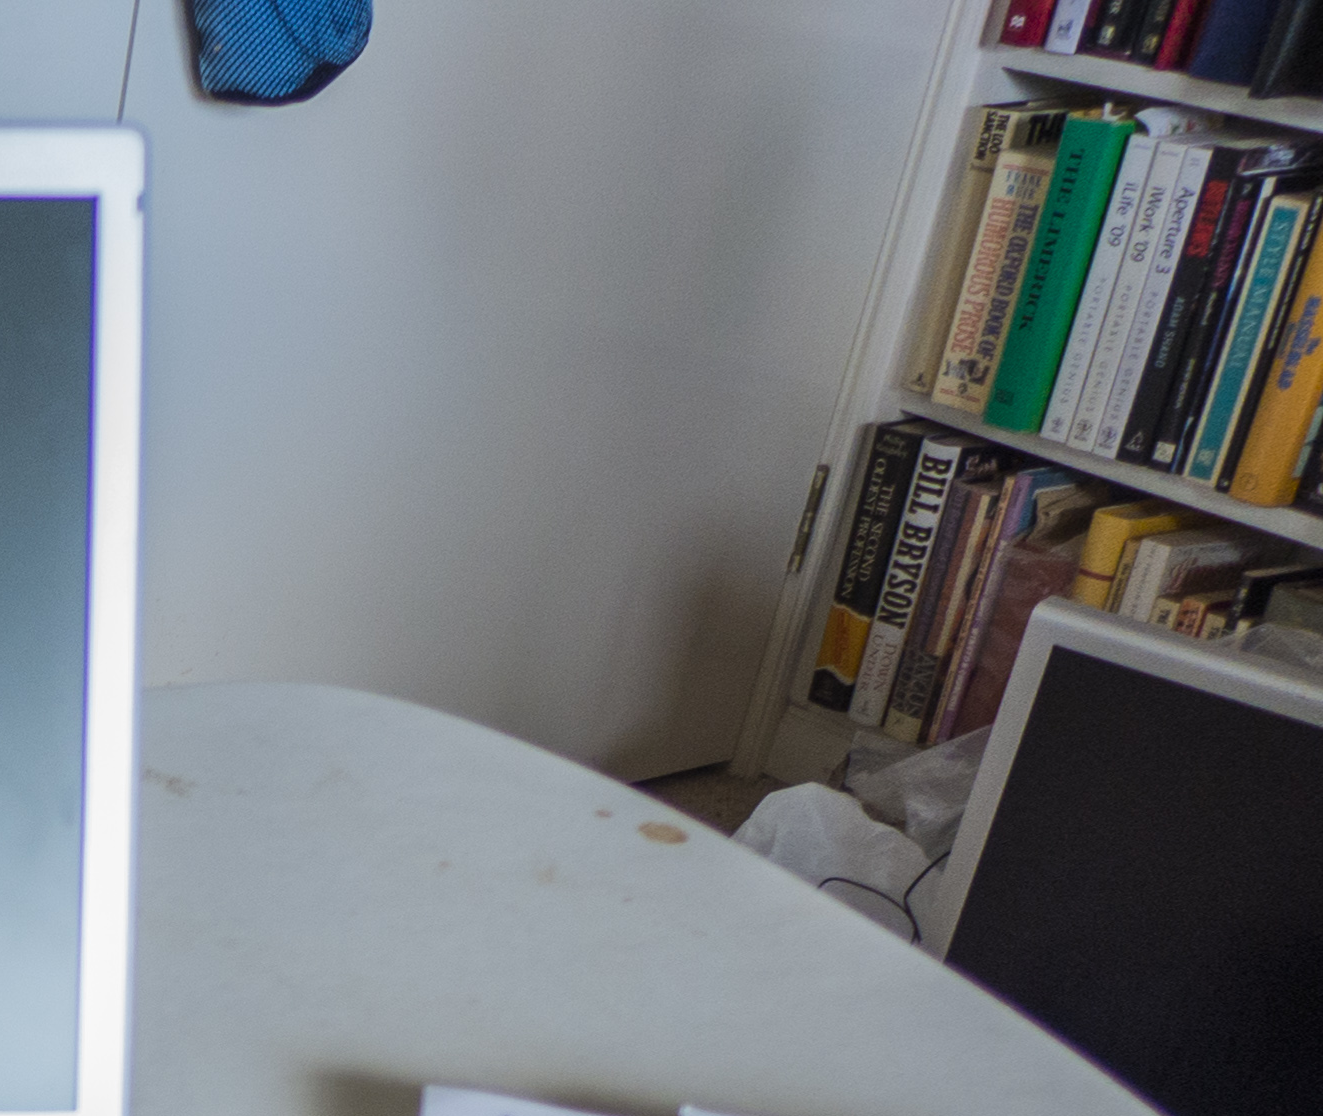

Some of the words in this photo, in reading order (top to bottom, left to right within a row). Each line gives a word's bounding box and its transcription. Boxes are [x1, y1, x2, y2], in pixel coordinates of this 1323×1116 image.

[994, 112, 1008, 134] THE
[1056, 147, 1084, 203] THE
[1115, 181, 1136, 217] iLife
[1013, 202, 1037, 235] THE
[1138, 186, 1164, 234] iWork
[1158, 187, 1193, 259] Aperture
[966, 197, 1016, 298] HUMOROUS
[995, 235, 1025, 296] OXFORD
[1018, 211, 1065, 331] LIMERICK
[1155, 263, 1169, 276] 3
[950, 298, 986, 356] PROSE
[982, 297, 1008, 339] BOOK
[975, 338, 995, 362] OF
[861, 457, 888, 513] OLDEST
[874, 483, 894, 516] THE
[908, 453, 951, 519] BILL
[838, 517, 871, 597] PROFESSION
[856, 520, 884, 581] SECOND
[877, 521, 931, 629] BRYSON
[857, 633, 883, 692] UNDER
[872, 643, 896, 692] DOWN
